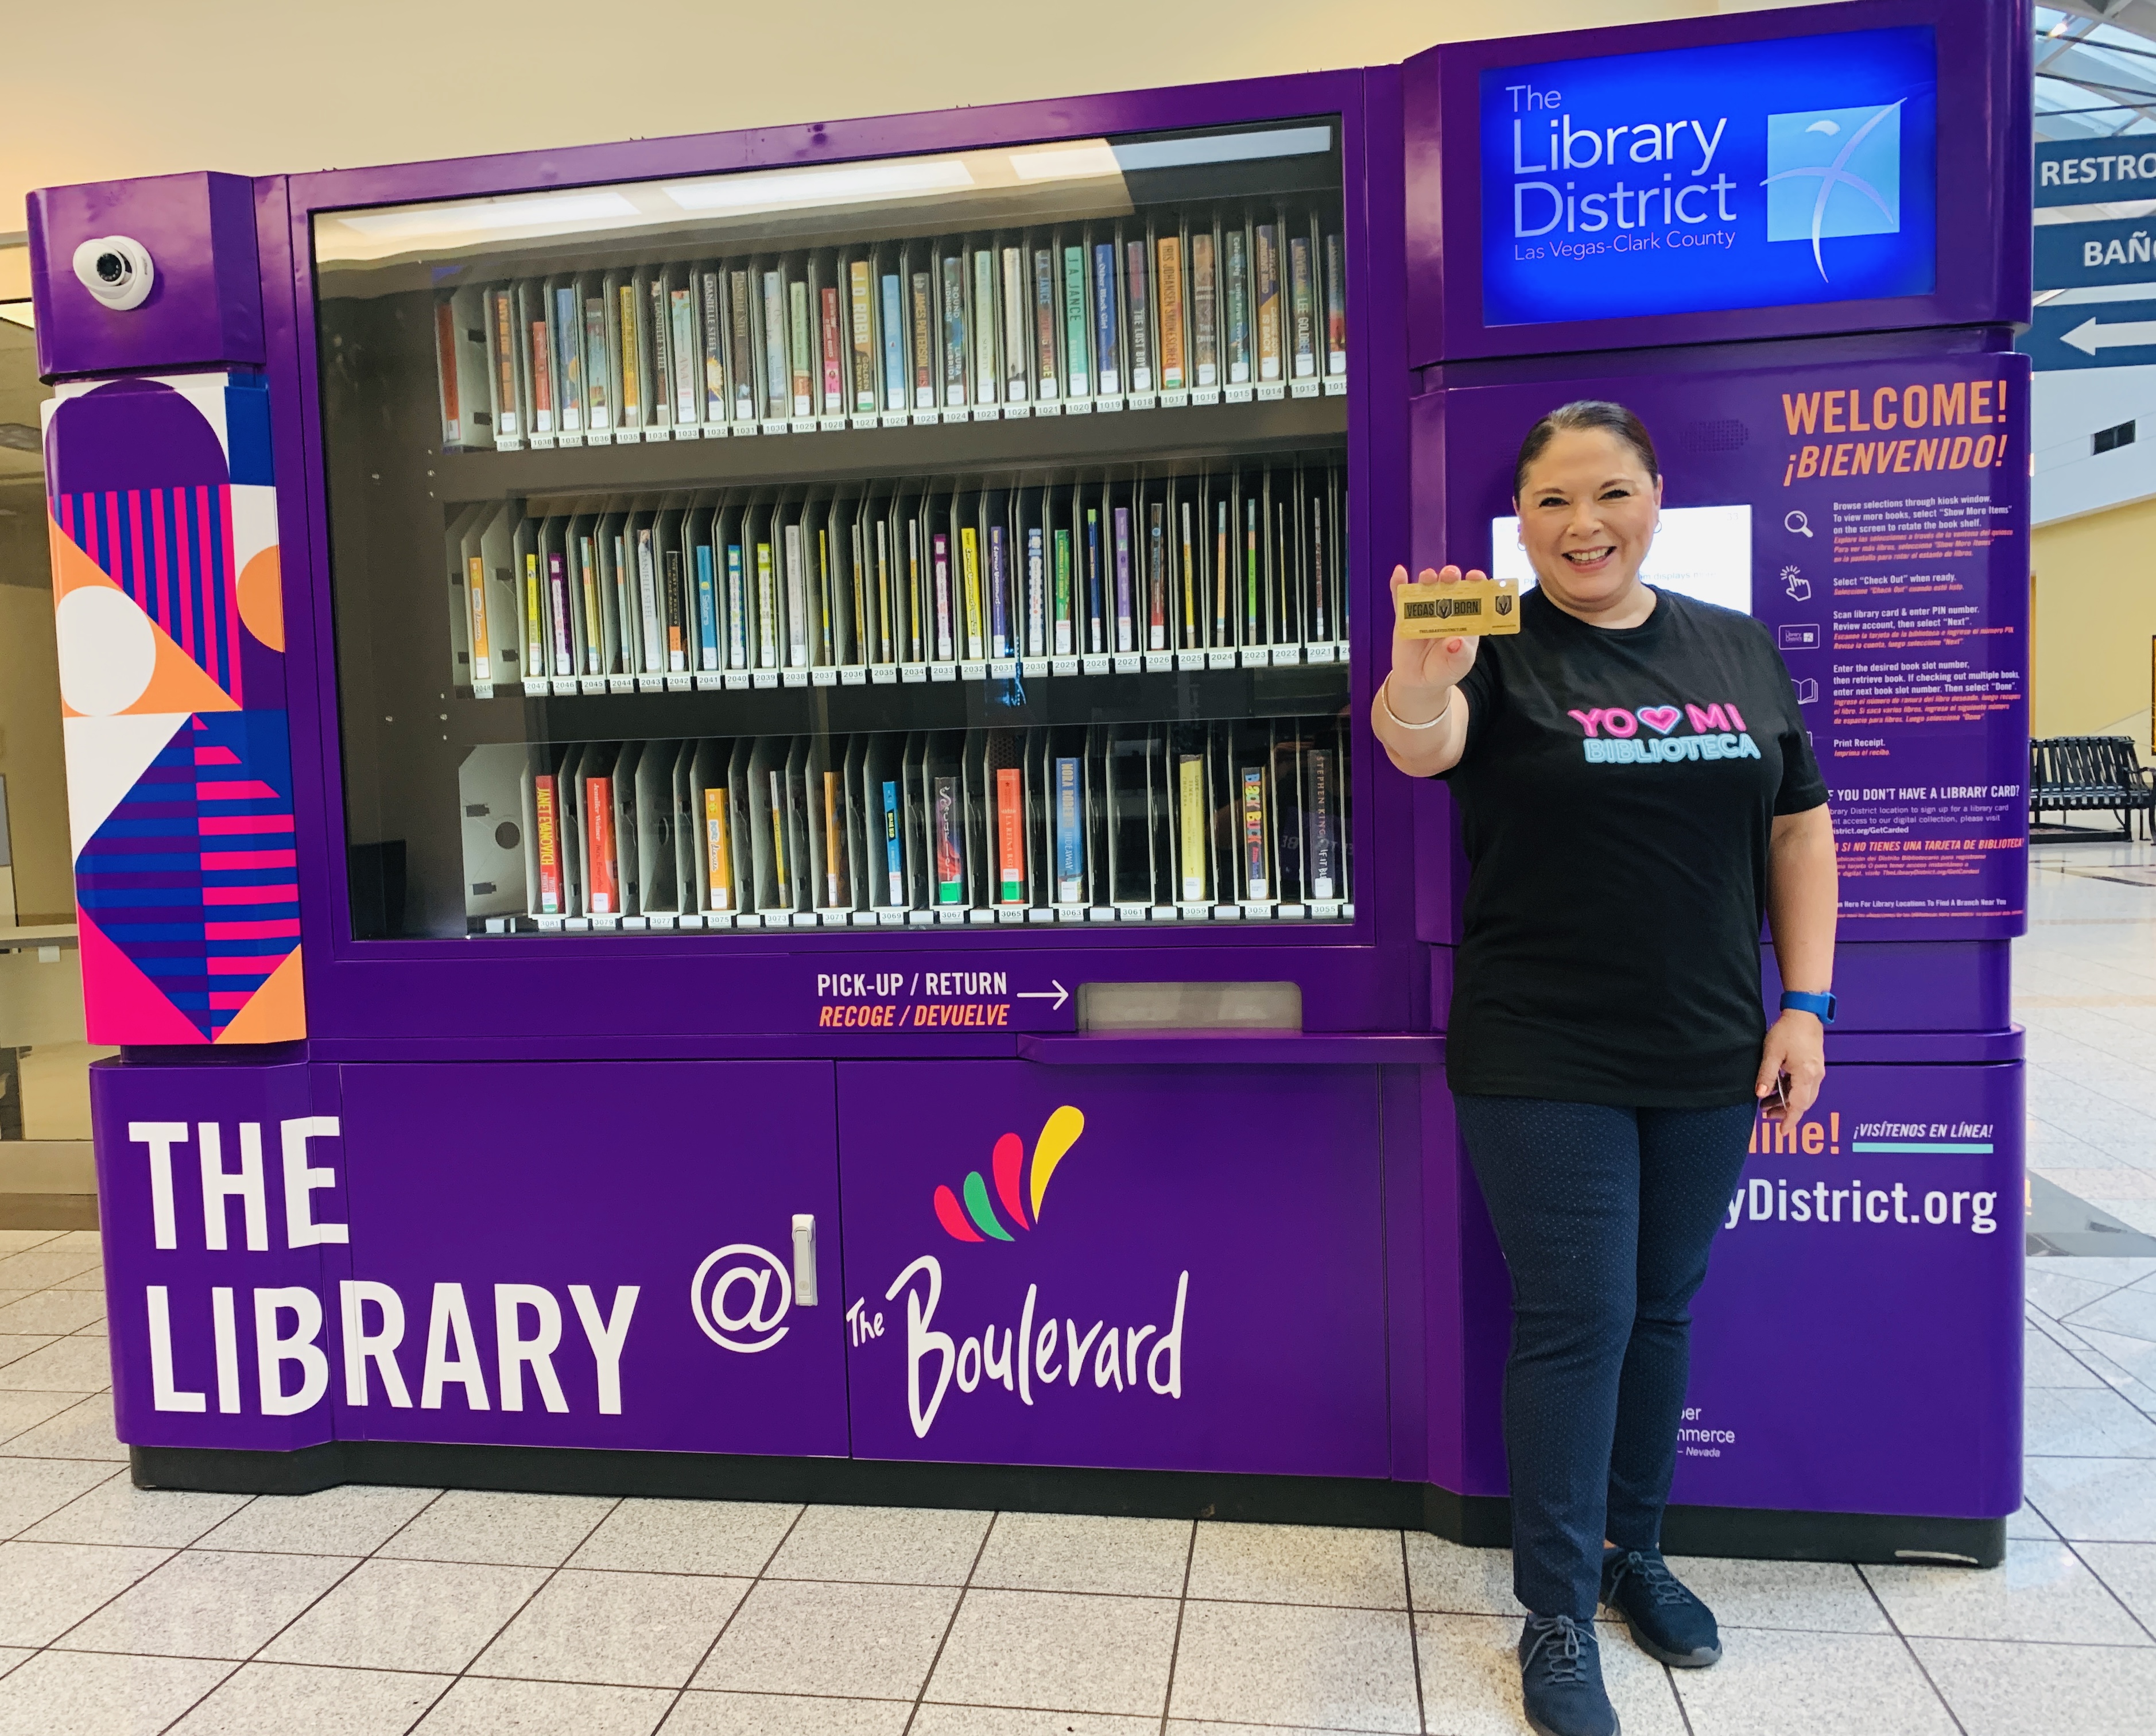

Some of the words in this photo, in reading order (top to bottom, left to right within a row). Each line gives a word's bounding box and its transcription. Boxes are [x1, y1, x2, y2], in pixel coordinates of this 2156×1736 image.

[1506, 85, 1561, 113] The
[1514, 113, 1727, 176] Library
[1514, 173, 1737, 238] District
[1514, 244, 1544, 261] Las
[1549, 230, 1661, 261] Vegas-Clark
[1666, 230, 1736, 250] County
[2084, 230, 2156, 267] BAÑ
[1134, 330, 1145, 347] LOST
[1782, 380, 2007, 435] WELCOME!
[1783, 434, 2007, 487] ¡BIENVENIDO!
[1833, 502, 1861, 510] Browse
[1864, 500, 1903, 509] selections
[1905, 498, 1935, 507] through
[1938, 496, 1958, 505] kiosk
[1961, 495, 1991, 503] window.
[1886, 511, 1910, 520] books,
[1913, 510, 1937, 518] select
[1940, 508, 1964, 516] “Show
[1967, 507, 1986, 515] More
[1898, 522, 1921, 530] rotate
[1924, 521, 1936, 529] the
[1938, 520, 1957, 528] book
[1960, 518, 1981, 527] shelf.
[1653, 572, 1691, 581] displays
[1833, 578, 1857, 586] Select
[1860, 576, 1887, 584] “Check
[1890, 575, 1907, 583] Out”
[1910, 574, 1930, 582] when
[1933, 573, 1956, 582] ready.
[1406, 603, 1434, 617] VEGAS
[1454, 600, 1479, 615] BORN
[1833, 611, 1852, 619] Scan
[1854, 610, 1879, 618] library
[1882, 609, 1899, 617] card
[1902, 608, 1907, 616] &
[1932, 606, 1946, 614] PIN
[1948, 606, 1979, 614] number.
[1833, 622, 1860, 630] Review
[1862, 621, 1895, 629] account,
[1898, 620, 1914, 628] then
[1917, 619, 1941, 627] select
[1943, 617, 1971, 626] “Next”.
[1833, 665, 1853, 673] Enter
[1870, 662, 1898, 671] desired
[1901, 662, 1920, 670] book
[1922, 661, 1936, 669] slot
[1938, 661, 1969, 669] number,
[1852, 676, 1882, 684] retrieve
[1884, 675, 1905, 683] book.
[1916, 673, 1952, 682] checking
[1954, 672, 1966, 680] out
[1968, 671, 1999, 680] multiple
[1874, 687, 1893, 695] book
[1895, 686, 1909, 694] slot
[1911, 685, 1941, 693] number.
[1965, 683, 1989, 691] select
[1568, 707, 1637, 738] YO
[1685, 703, 1747, 733] MI
[1583, 733, 1762, 764] BIBLIOTECA
[1855, 739, 1885, 747] Receipt.
[1316, 755, 1325, 804] STEPHEN
[536, 787, 552, 813] JANET
[1837, 789, 1859, 801] YOU
[1863, 788, 1895, 800] DON'T
[1899, 788, 1926, 799] HAVE
[1930, 788, 1937, 799] A
[1941, 786, 1987, 799] LIBRARY
[1991, 785, 2019, 797] CARD?
[1246, 811, 1262, 844] BUCK
[1317, 809, 1326, 835] KING
[538, 816, 554, 866] EVANOVICH
[1841, 842, 1851, 851] SI
[1853, 842, 1866, 851] NO
[1870, 841, 1901, 851] TIENES
[1903, 841, 1921, 851] UNA
[1925, 840, 1960, 850] TARJETA
[1964, 840, 1976, 850] DE
[817, 973, 903, 997] PICK-UP
[910, 972, 920, 996] /
[925, 971, 1007, 995] RETURN
[819, 1005, 895, 1028] RECOGE
[899, 1005, 910, 1026] /
[913, 1003, 1010, 1026] DEVUELVE
[1853, 1121, 1925, 1140] ¡VISÍTENOS
[1929, 1123, 1948, 1138] EN
[1951, 1121, 1994, 1139] LÍNEA!
[128, 1115, 350, 1252] THE
[691, 1243, 792, 1353] @
[846, 1297, 885, 1347] The
[145, 1280, 641, 1416] LIBRARY
[885, 1255, 1189, 1439] Boulevard
[1685, 1446, 1721, 1458] Nevada
